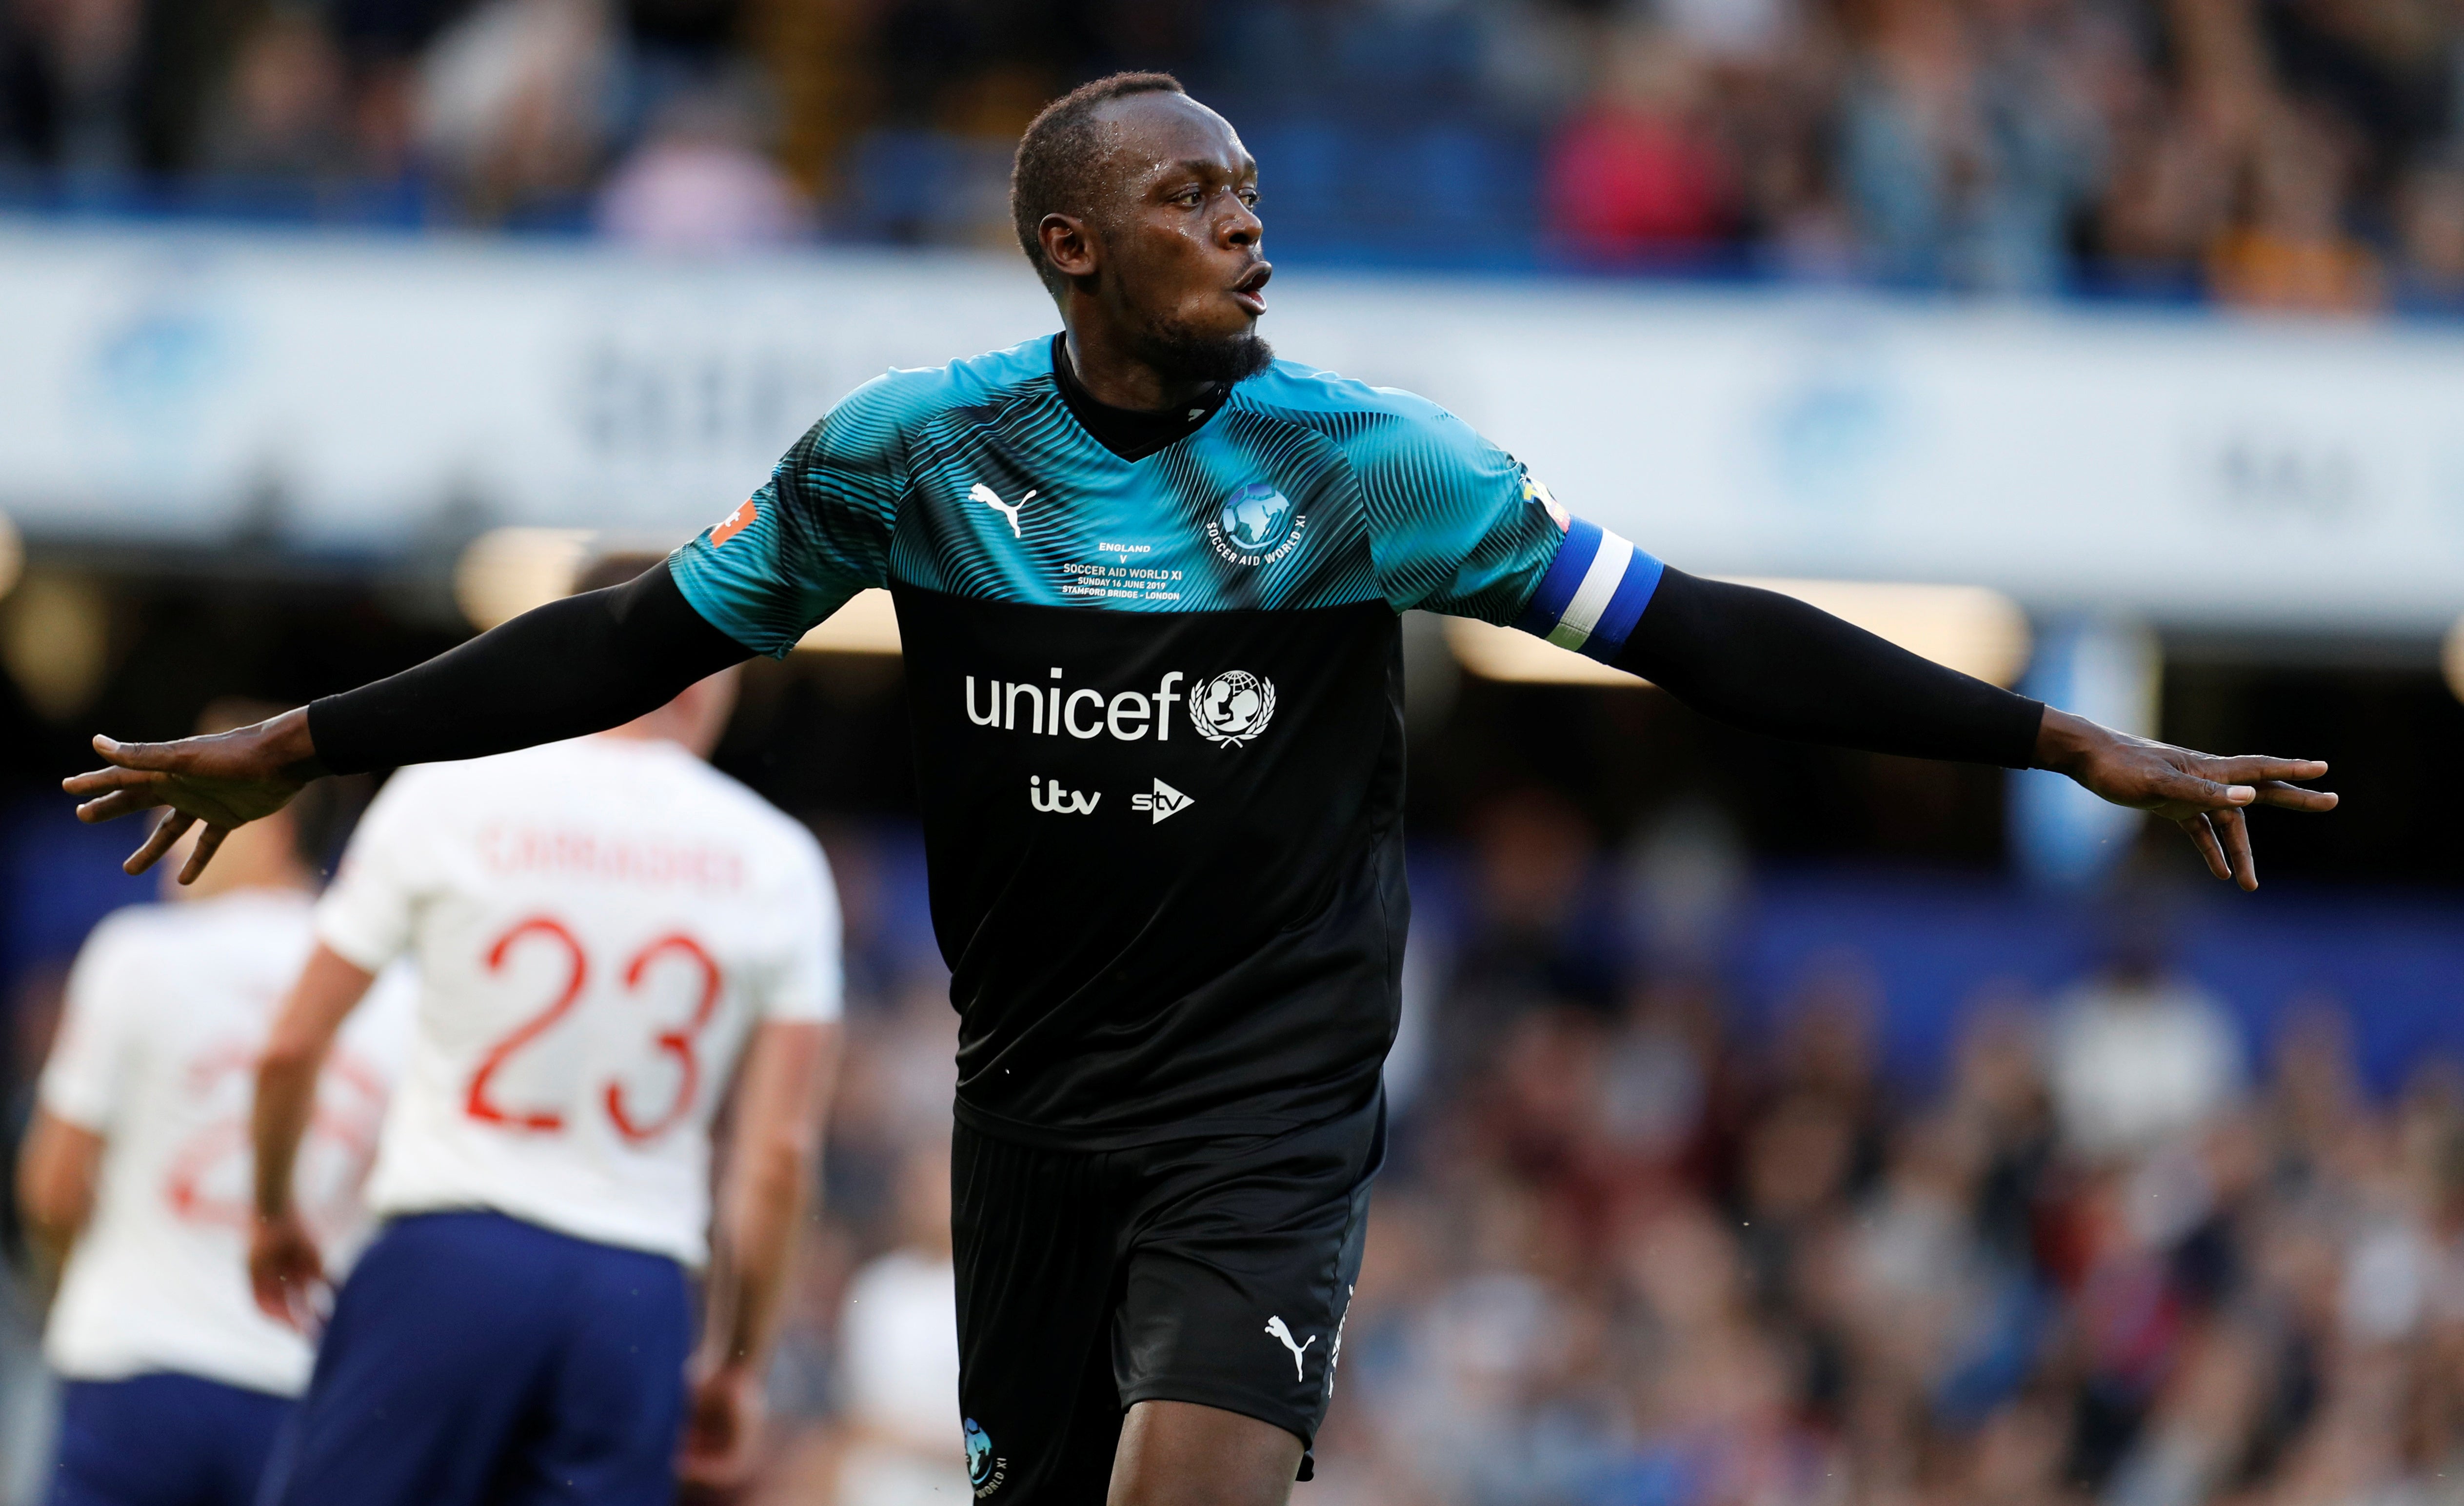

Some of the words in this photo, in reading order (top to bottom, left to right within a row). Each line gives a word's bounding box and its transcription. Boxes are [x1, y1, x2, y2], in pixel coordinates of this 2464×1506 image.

[1099, 542, 1151, 553] ENGLAND
[1207, 522, 1237, 563] SOCCER
[1238, 555, 1260, 566] AID
[1264, 531, 1301, 564] WORLD
[1295, 515, 1306, 528] XI
[1063, 563, 1105, 576] SOCCER
[1108, 568, 1126, 577] AID
[1129, 569, 1169, 579] WORLD
[1171, 571, 1182, 580] XI
[1077, 577, 1111, 587] SUNDAY
[1123, 580, 1145, 589] JUNE
[1062, 585, 1106, 596] STAMFORD
[1107, 589, 1138, 598] BRIDGE
[966, 667, 1183, 741] unicef
[1031, 775, 1101, 814] itv
[463, 912, 722, 1146] 23
[975, 1472, 1004, 1498] WORLD
[997, 1458, 1007, 1469] XI
